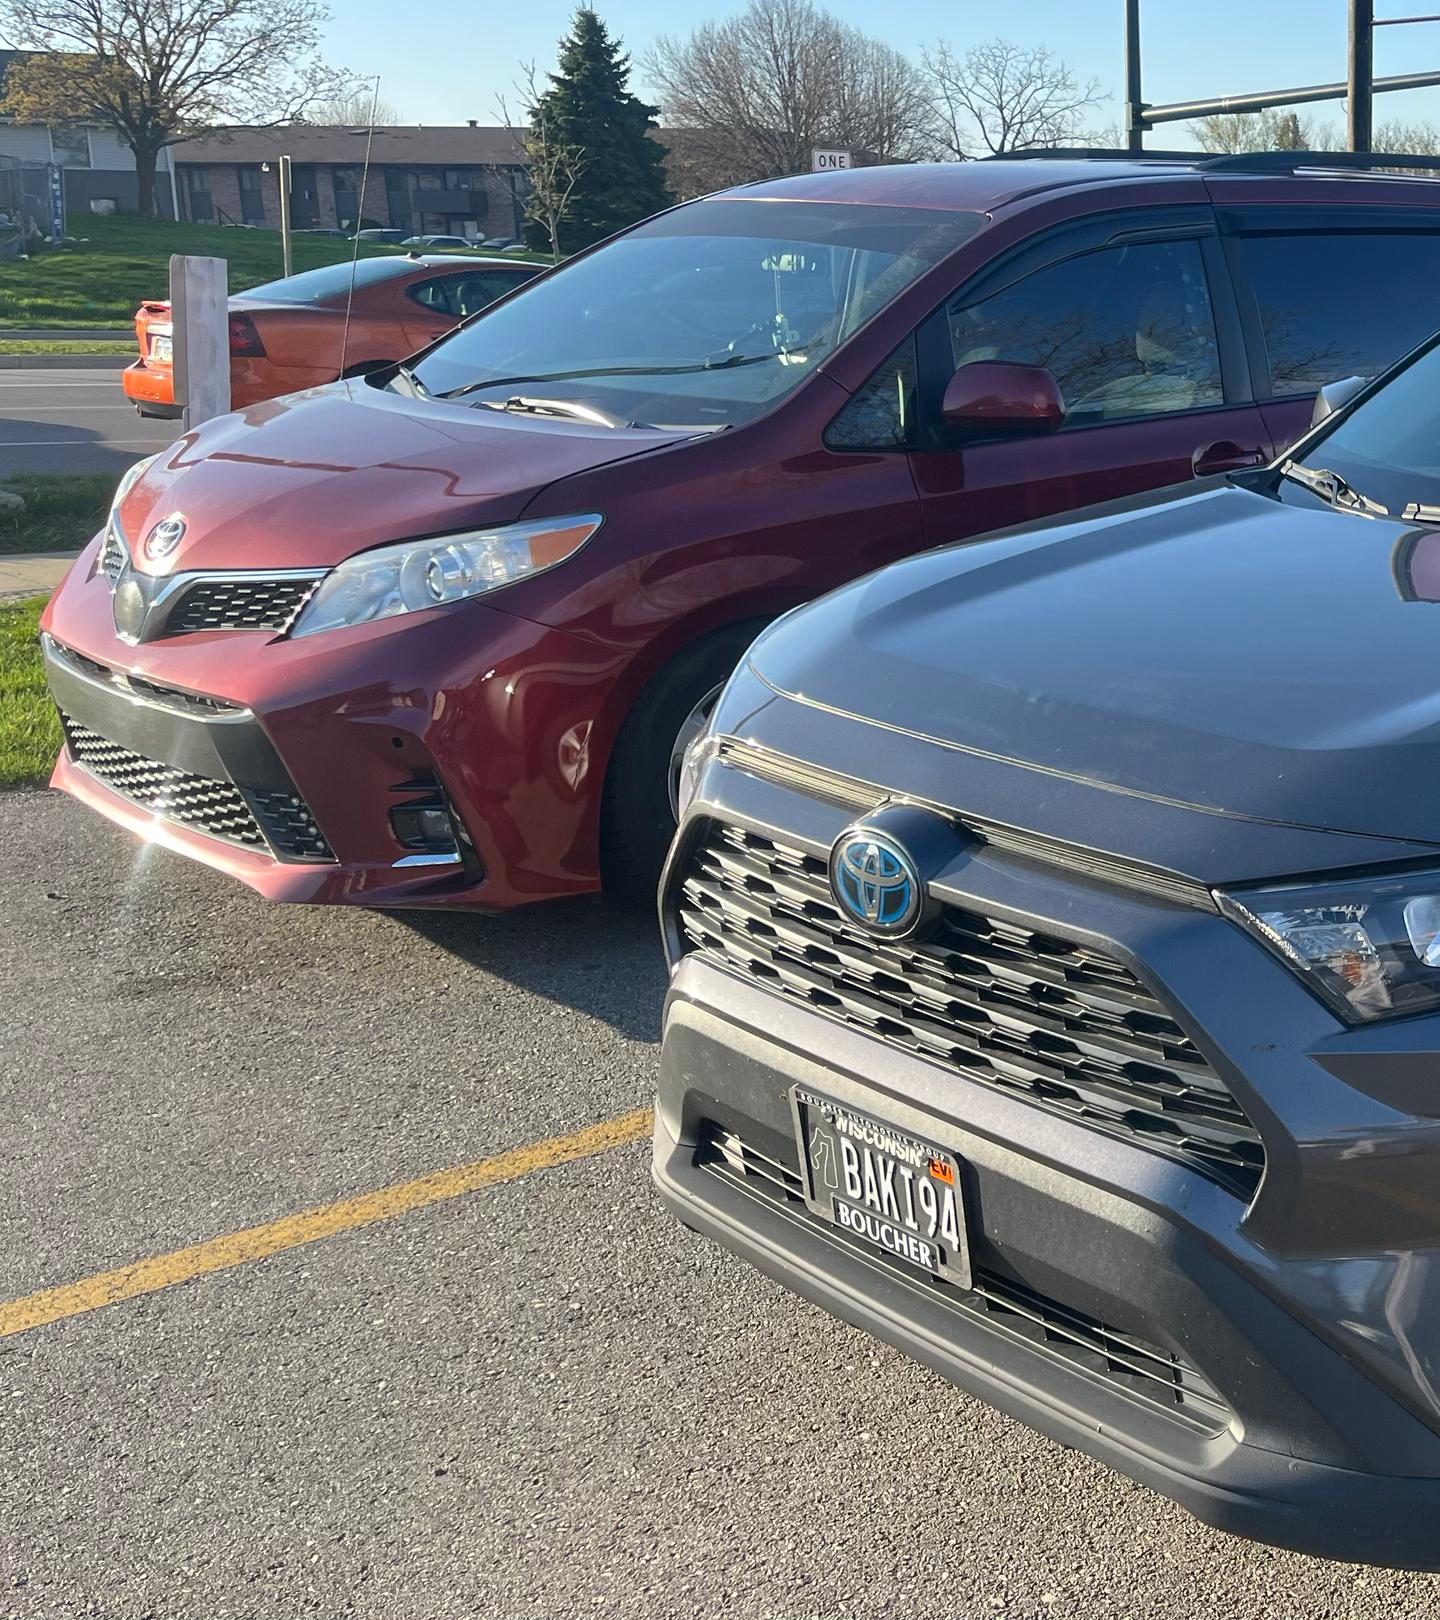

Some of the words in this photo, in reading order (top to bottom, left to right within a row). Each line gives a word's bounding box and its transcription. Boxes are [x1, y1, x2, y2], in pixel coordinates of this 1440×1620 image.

[818, 155, 846, 169] ONE
[800, 1092, 844, 1116] BOUCHER
[848, 1113, 909, 1146] AUTOMOTIVE
[912, 1141, 946, 1162] GROUP
[835, 1115, 923, 1168] WISCONSIN
[837, 1201, 933, 1269] BOUCHER
